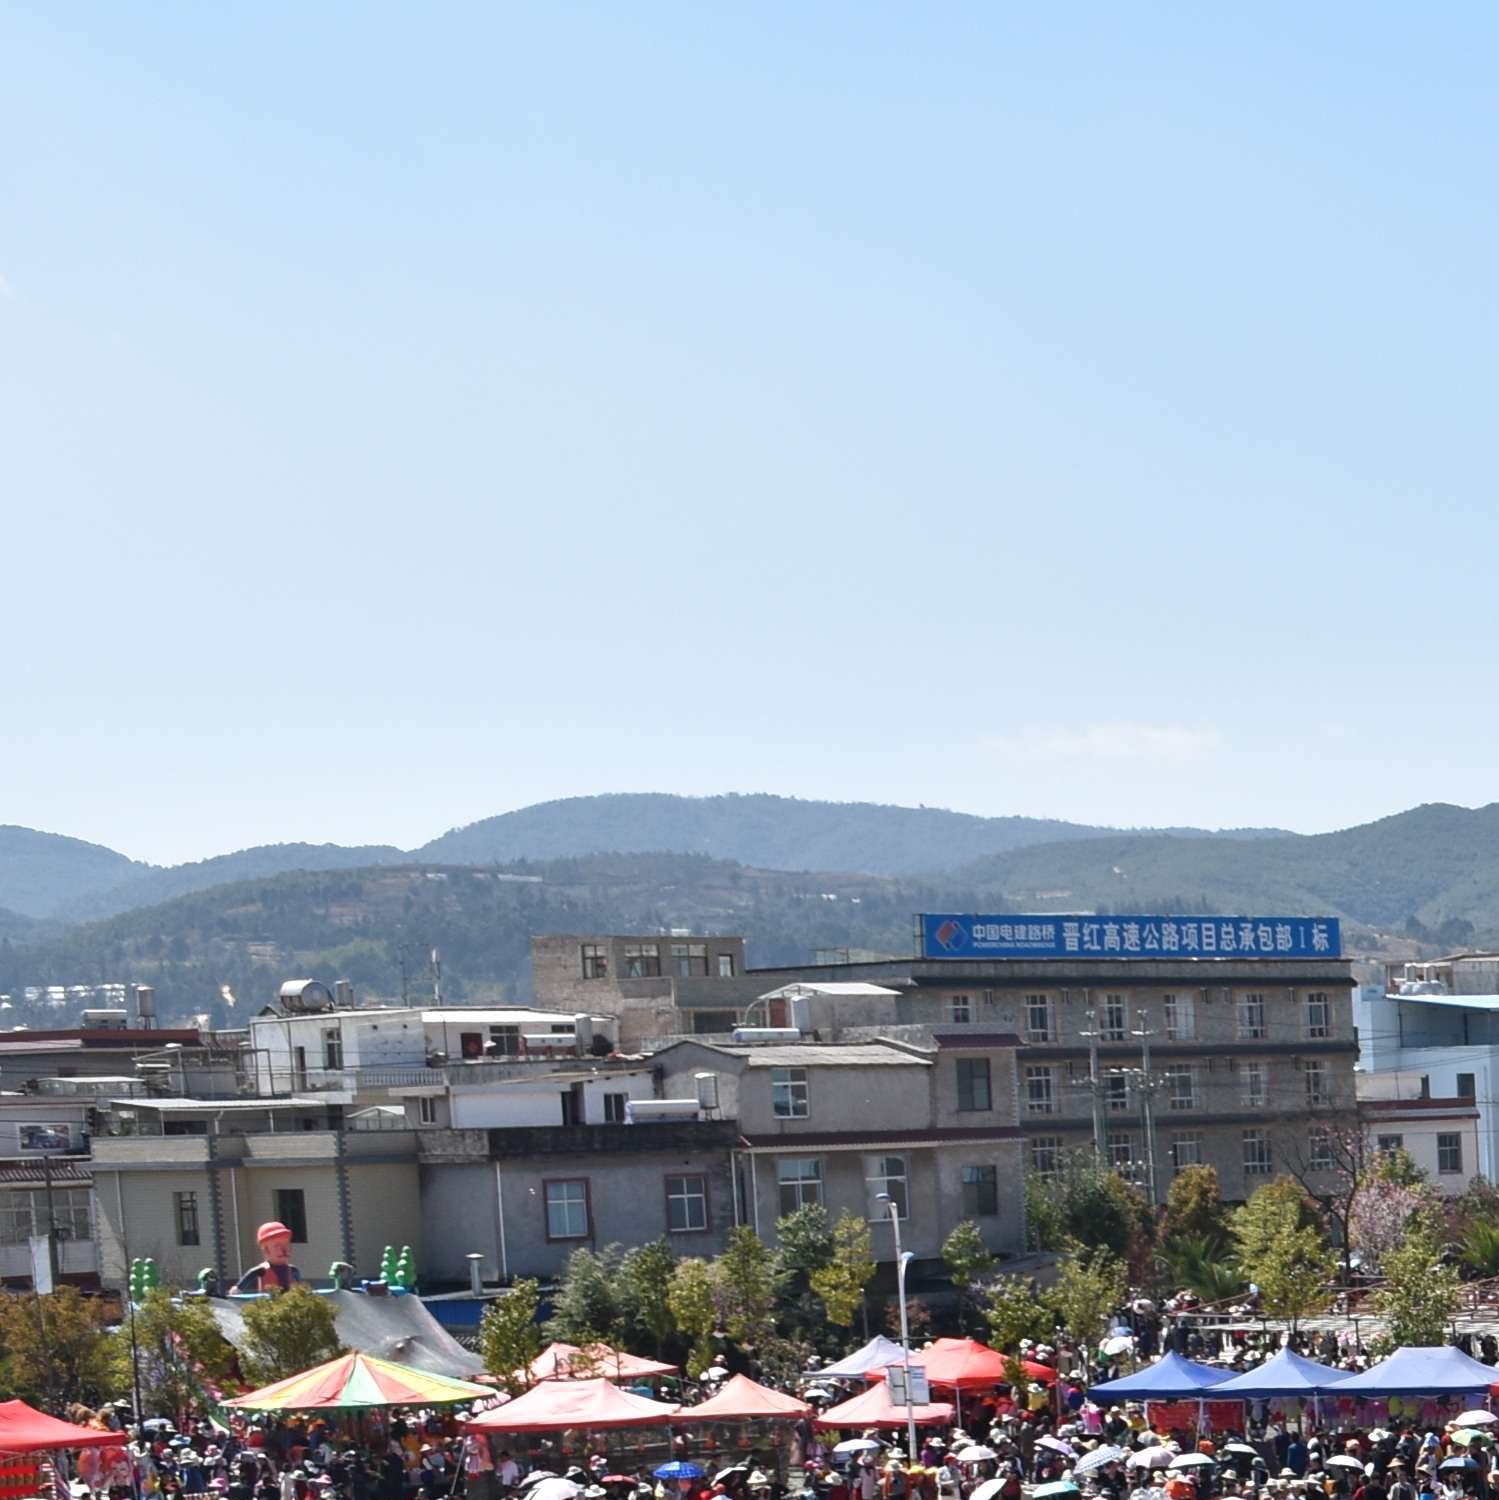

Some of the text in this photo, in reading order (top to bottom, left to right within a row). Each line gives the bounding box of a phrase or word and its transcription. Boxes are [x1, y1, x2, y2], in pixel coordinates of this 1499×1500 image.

[972, 924, 1056, 941] 中国电建路桥
